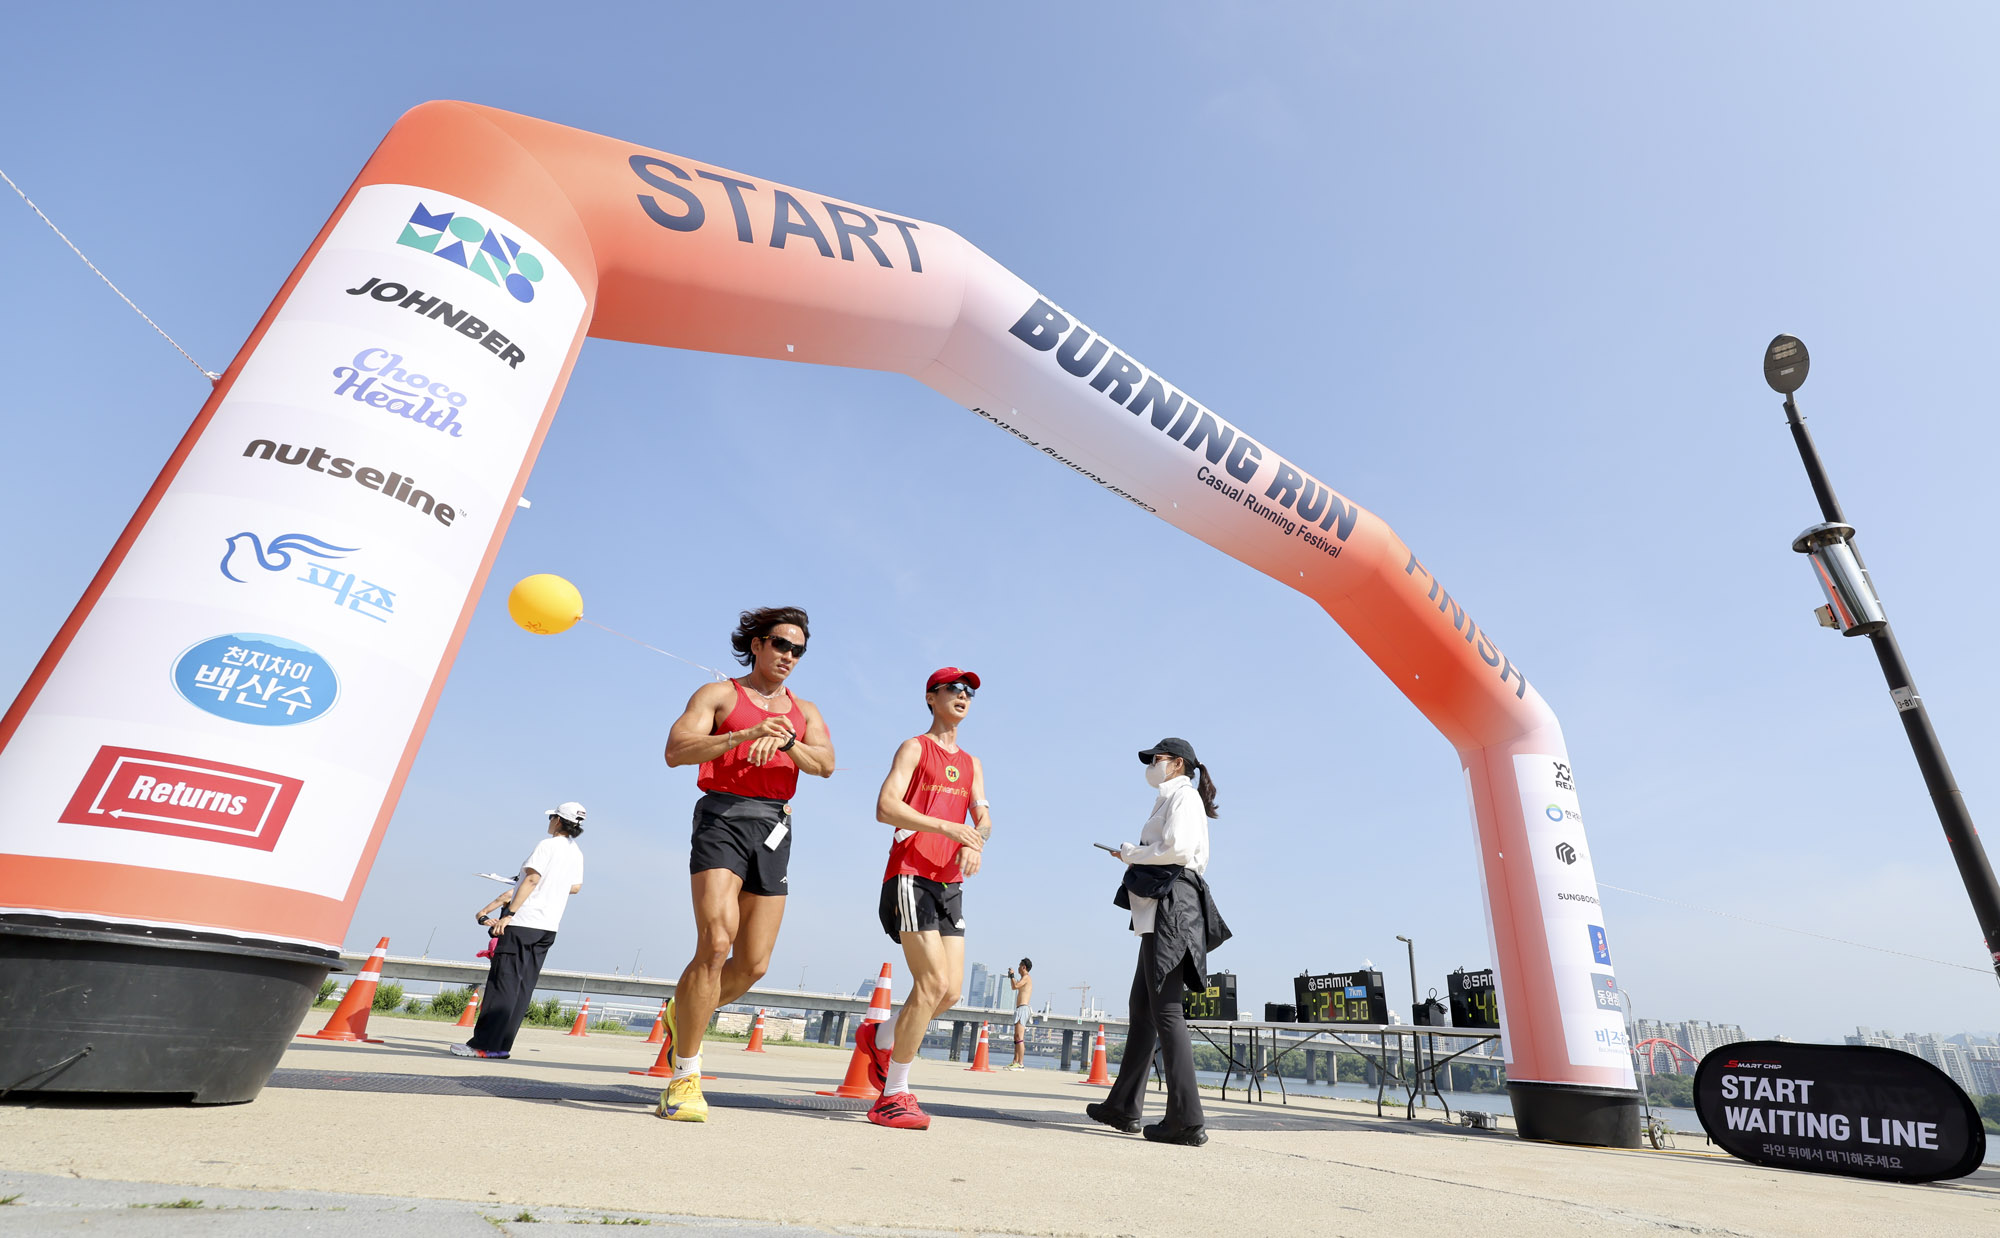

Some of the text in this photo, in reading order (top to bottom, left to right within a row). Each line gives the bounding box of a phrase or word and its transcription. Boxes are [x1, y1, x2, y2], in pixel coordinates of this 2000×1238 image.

[628, 154, 923, 273] START
[345, 277, 526, 370] JOHNBER
[332, 366, 463, 438] Health
[352, 347, 467, 407] Choco
[1007, 298, 1358, 543] BURNING RUN
[242, 439, 456, 528] nutseline
[971, 407, 1157, 513] Casual Running Festival
[1196, 466, 1343, 559] Casual Running Festival
[296, 561, 397, 623] 피존
[194, 663, 313, 716] 백산수
[221, 645, 313, 683] 천지차이
[127, 775, 248, 816] Returns
[1317, 976, 1353, 989] SAMIK
[1348, 988, 1363, 997] 7km
[1721, 1074, 1815, 1105] START
[1724, 1060, 1762, 1069] SMART
[1724, 1105, 1939, 1150] WAITING LINE
[1762, 1143, 1903, 1169] 라인 뒤에서 대기해주세요
